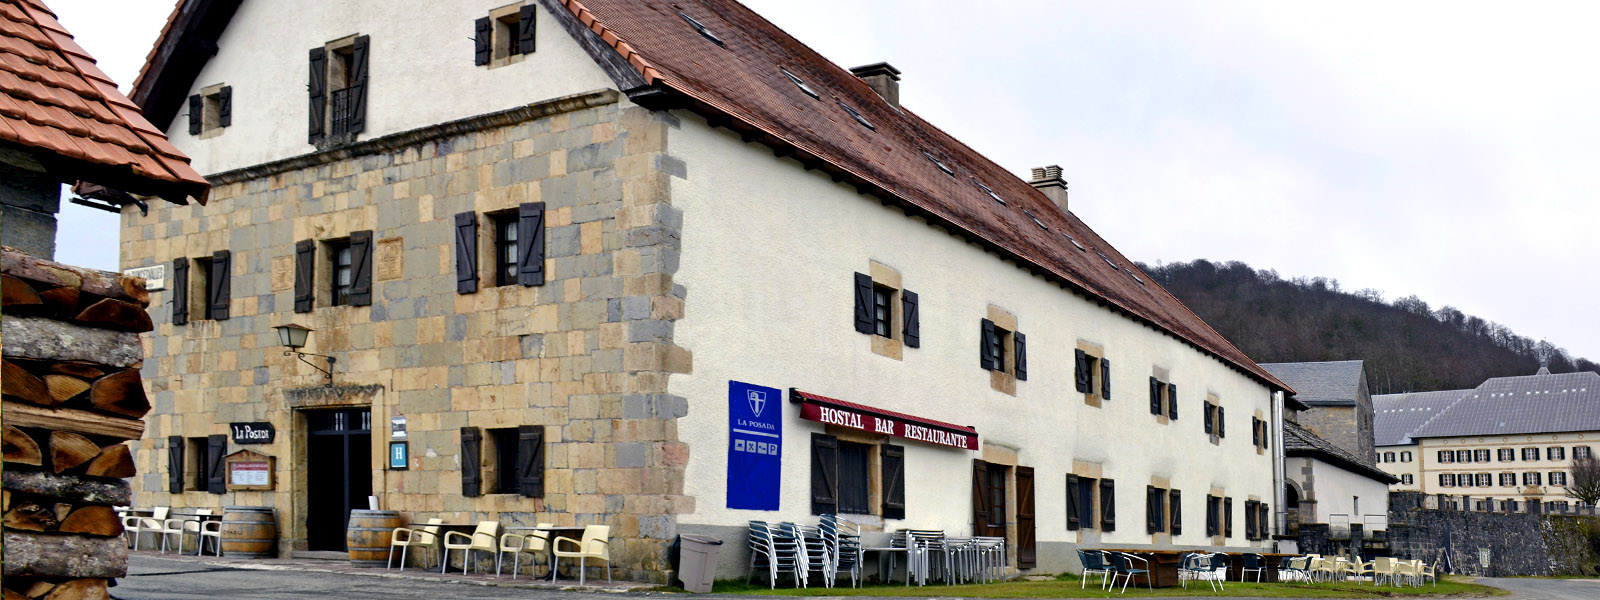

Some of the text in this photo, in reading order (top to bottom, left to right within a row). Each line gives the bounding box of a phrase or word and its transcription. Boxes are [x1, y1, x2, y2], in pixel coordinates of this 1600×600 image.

[737, 418, 775, 431] LA POSADA
[819, 406, 968, 449] HOSTAL BAR RESTAURANTE
[395, 446, 403, 460] H
[769, 444, 776, 454] P
